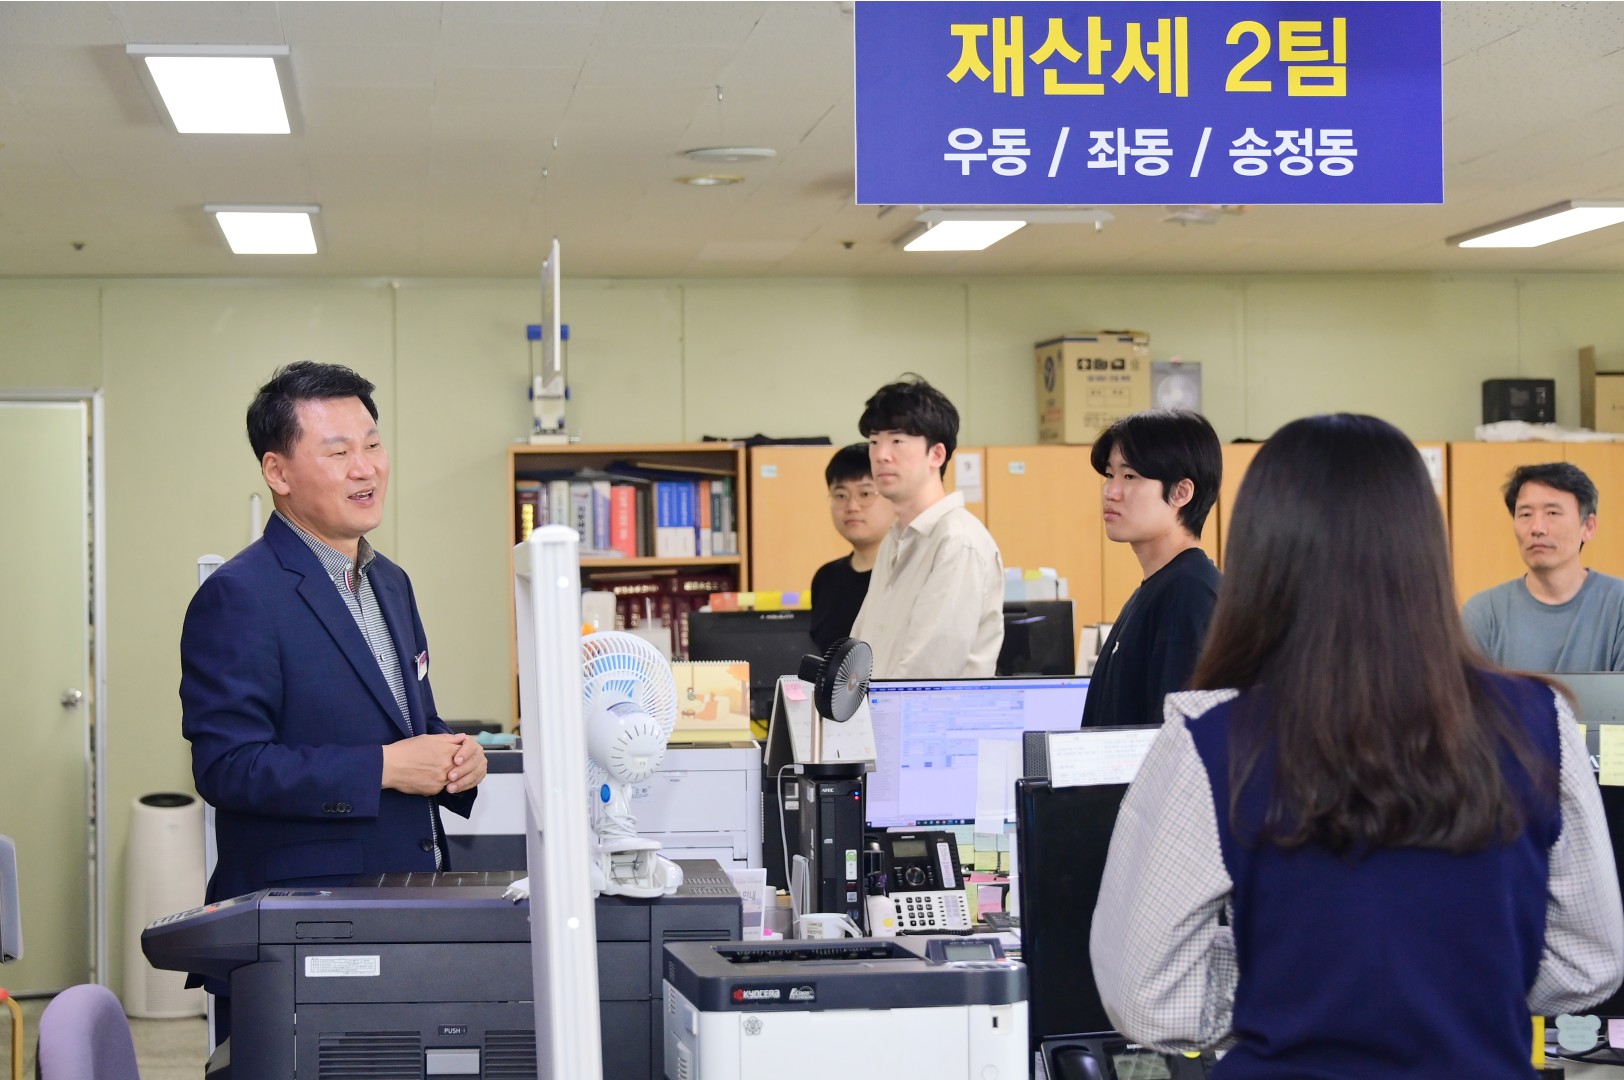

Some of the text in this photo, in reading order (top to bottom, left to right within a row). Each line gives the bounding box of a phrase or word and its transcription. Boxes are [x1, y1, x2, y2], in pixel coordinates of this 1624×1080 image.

[946, 15, 1347, 98] 재산세 2팀
[943, 126, 1358, 178] 우동 / 좌동 / 송정동
